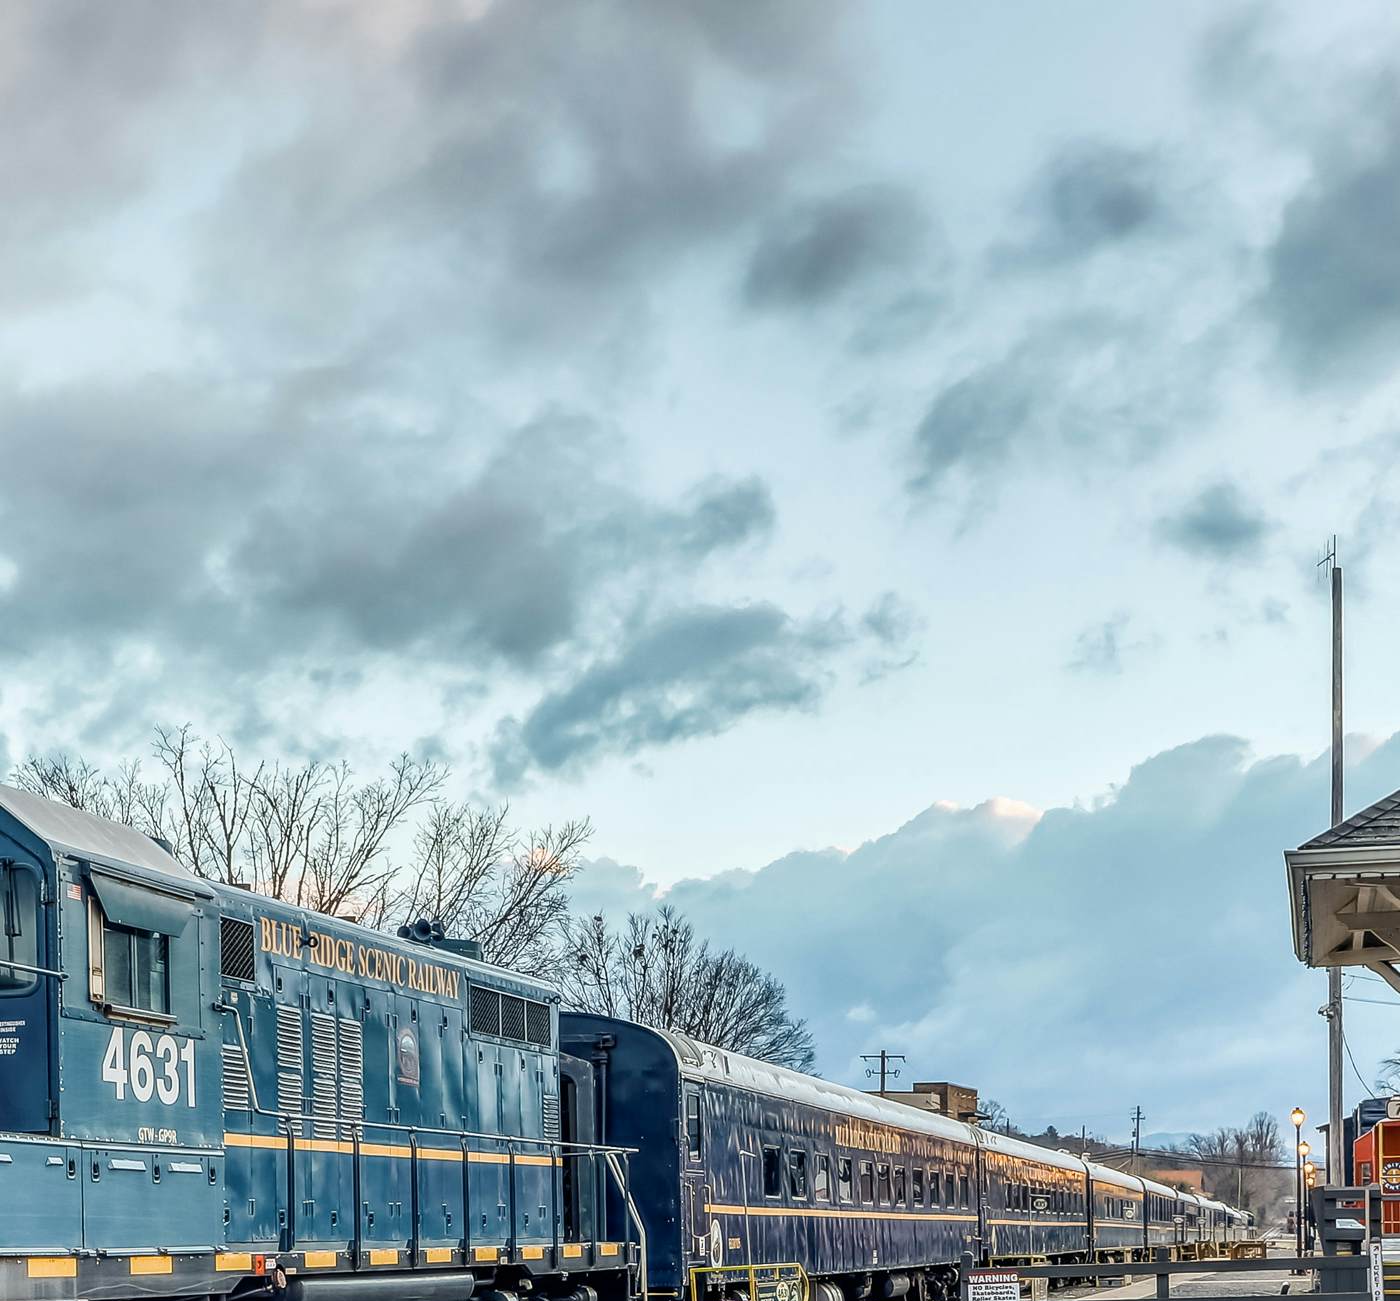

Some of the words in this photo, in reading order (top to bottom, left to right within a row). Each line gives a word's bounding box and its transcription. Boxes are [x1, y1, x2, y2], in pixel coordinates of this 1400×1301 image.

[260, 916, 302, 959] BLUE
[310, 930, 355, 975] RIDGE
[358, 944, 406, 987] SCENIC
[407, 958, 461, 1000] RAILWAY
[102, 1026, 196, 1108] 4631
[1382, 1162, 1400, 1173] VISIT
[968, 1273, 1018, 1283] WARNING
